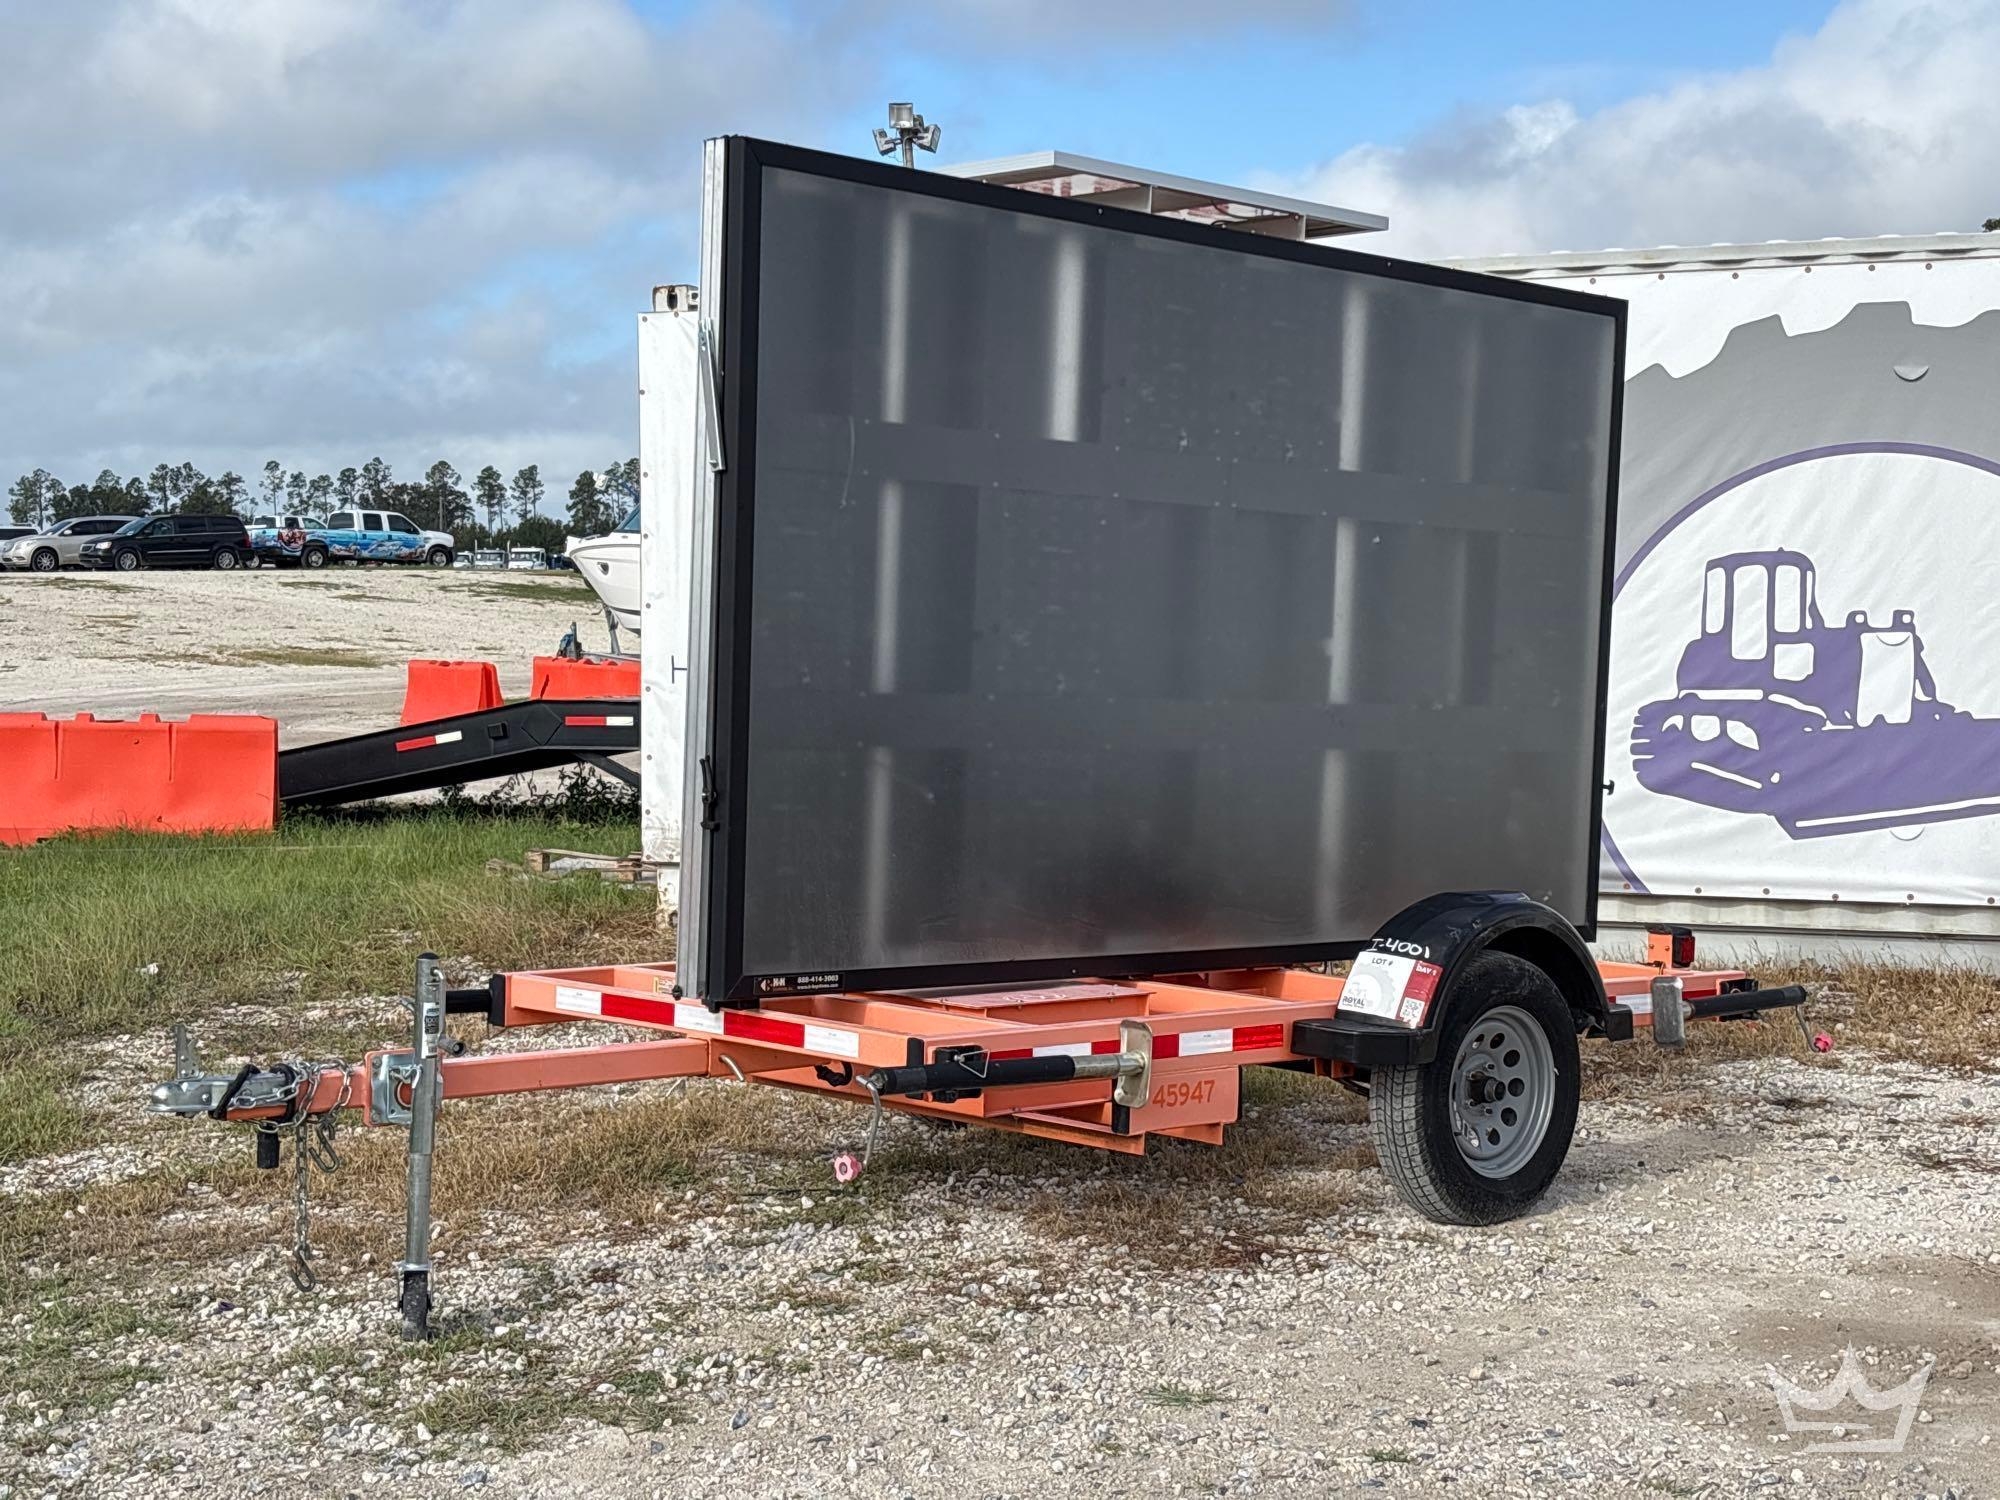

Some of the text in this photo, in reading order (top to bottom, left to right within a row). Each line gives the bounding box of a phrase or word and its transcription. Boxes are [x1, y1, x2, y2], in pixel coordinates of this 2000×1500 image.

[1371, 957, 1387, 966] LOT
[1416, 965, 1432, 975] DAY
[1342, 996, 1365, 1006] ROYAL
[1152, 1080, 1216, 1109] 45947
